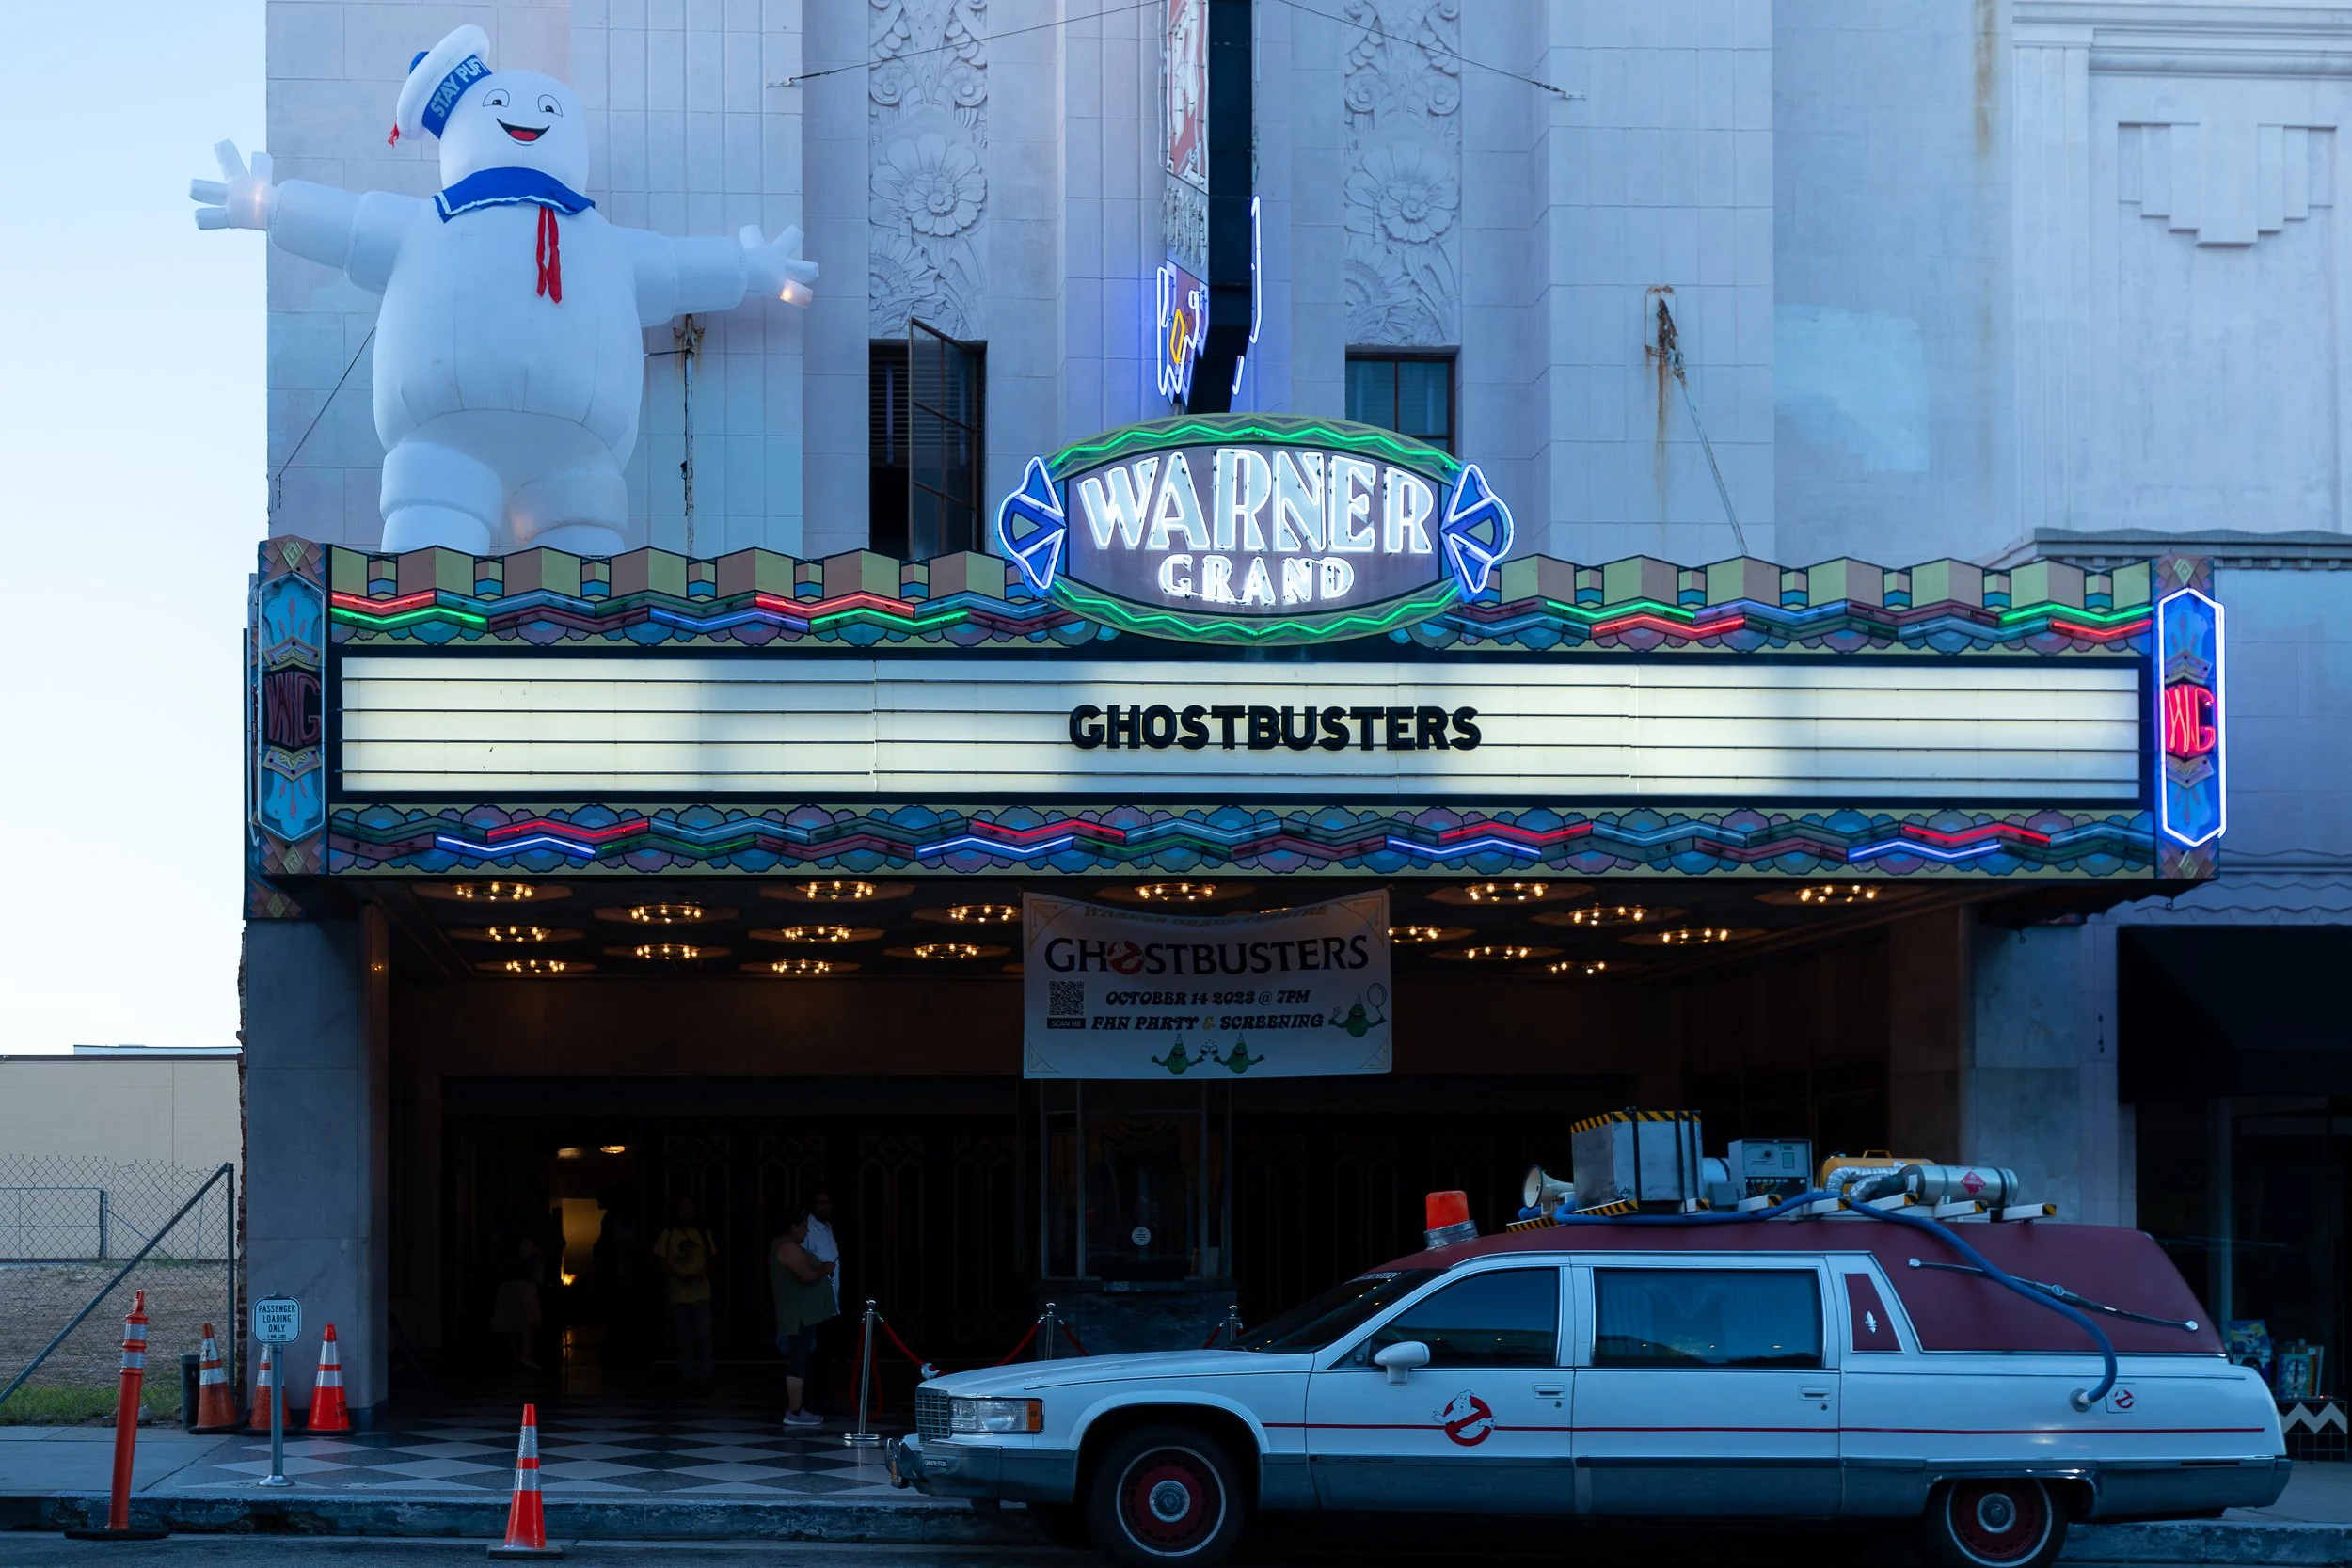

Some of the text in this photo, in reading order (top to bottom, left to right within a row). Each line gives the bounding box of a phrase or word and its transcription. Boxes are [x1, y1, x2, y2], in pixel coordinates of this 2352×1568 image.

[431, 74, 461, 118] STAY
[1076, 448, 1434, 554] WARNER
[1158, 553, 1355, 606] GRAND
[1069, 704, 1482, 751] GHOSTBUSTERS
[1105, 989, 1311, 1006] OCTOBER 14 2023 @ 7PM
[1050, 1019, 1083, 1028] SCAN ME
[1091, 1013, 1324, 1031] FAN PARTY & SCREENING
[258, 1305, 296, 1313] PASSENGER
[262, 1314, 292, 1323] LOADING
[268, 1323, 286, 1333] ONLY
